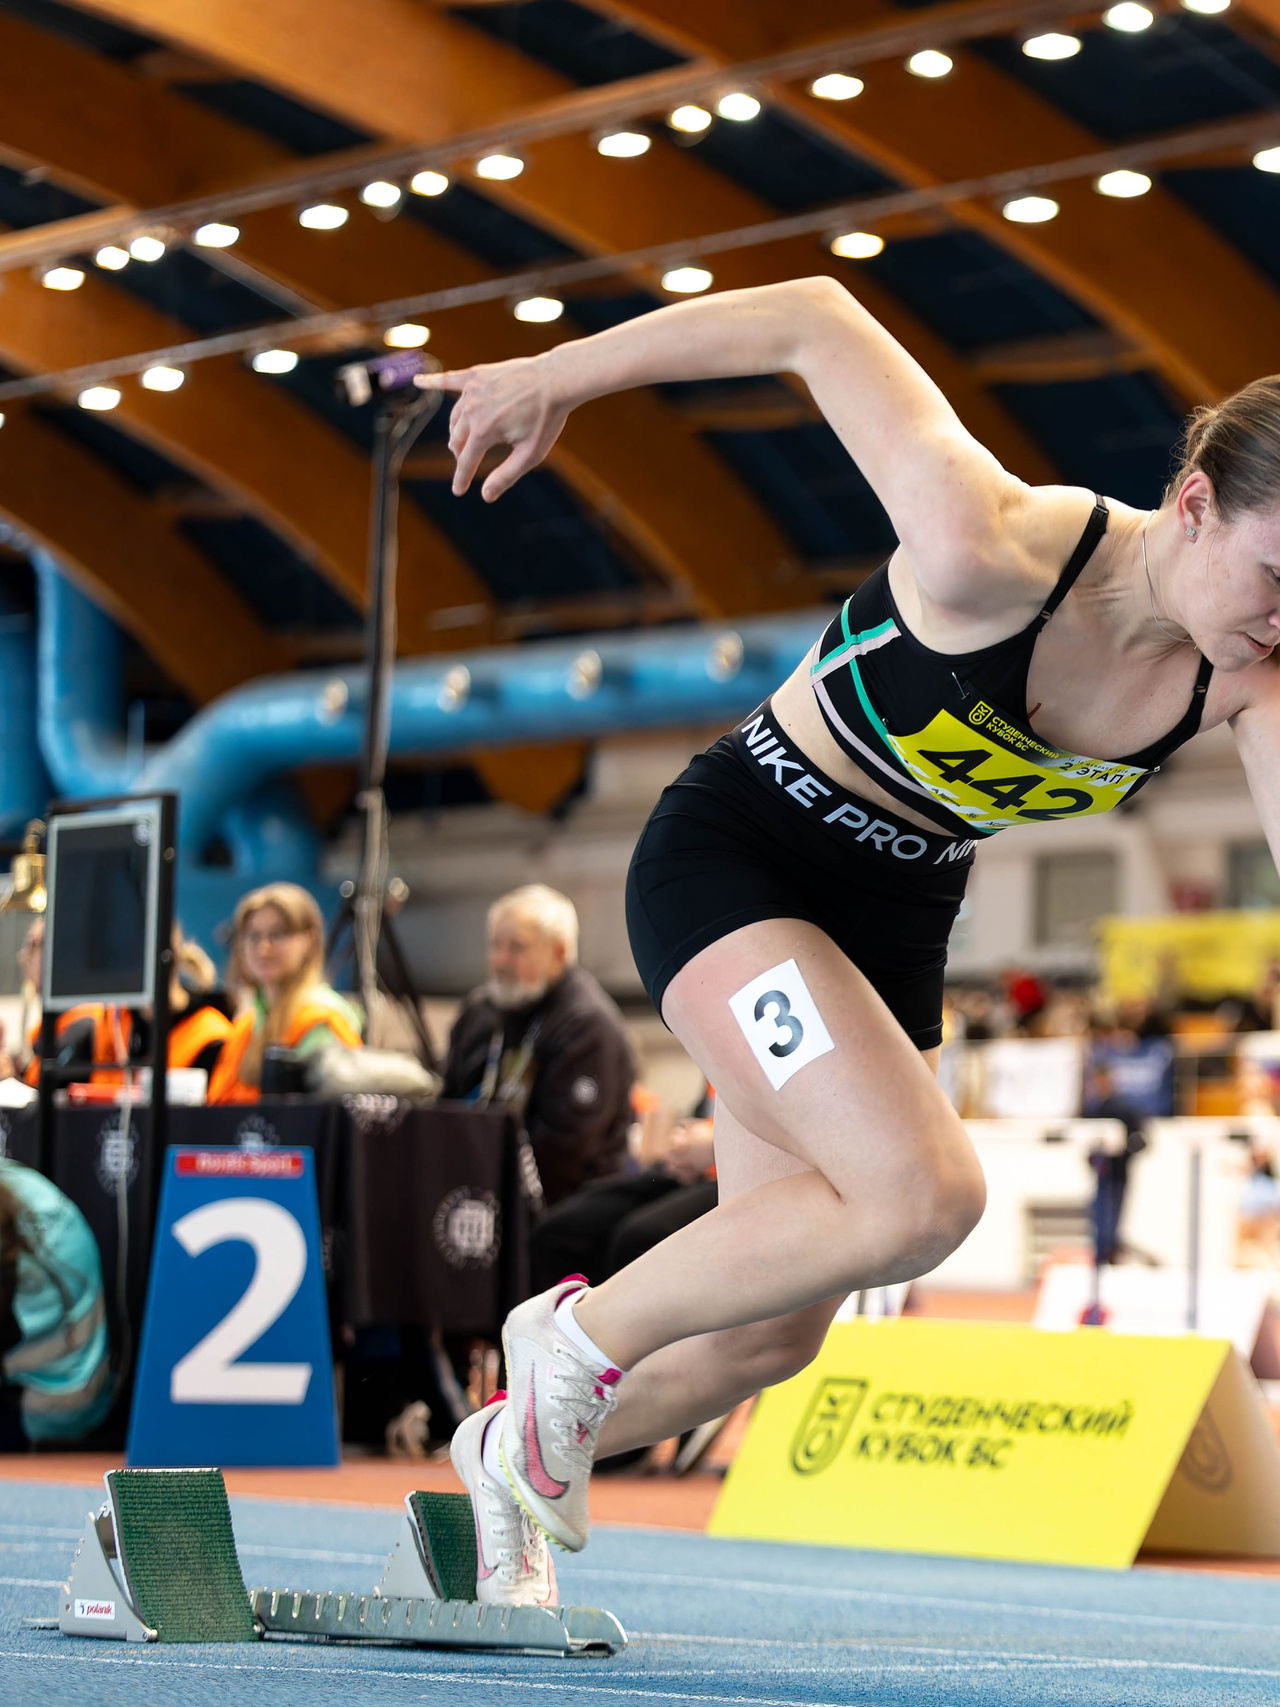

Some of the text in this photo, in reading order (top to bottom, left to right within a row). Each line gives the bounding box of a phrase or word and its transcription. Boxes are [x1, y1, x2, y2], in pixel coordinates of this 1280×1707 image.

[985, 721, 1029, 752] КУБОК БС
[992, 716, 1060, 759] СТУДЕНЧЕСКИЙ
[741, 713, 833, 809] NIKE
[823, 802, 928, 860] PRO
[916, 748, 1094, 821] 442
[1059, 762, 1074, 771] 2
[1076, 766, 1124, 785] ЭТАП
[753, 989, 804, 1058] 3
[171, 1196, 313, 1405] 2
[871, 1392, 1135, 1438] СТУДЕНЧЕСКИЙ
[856, 1430, 1016, 1470] КУБОК БС
[86, 1603, 112, 1616] polanik
